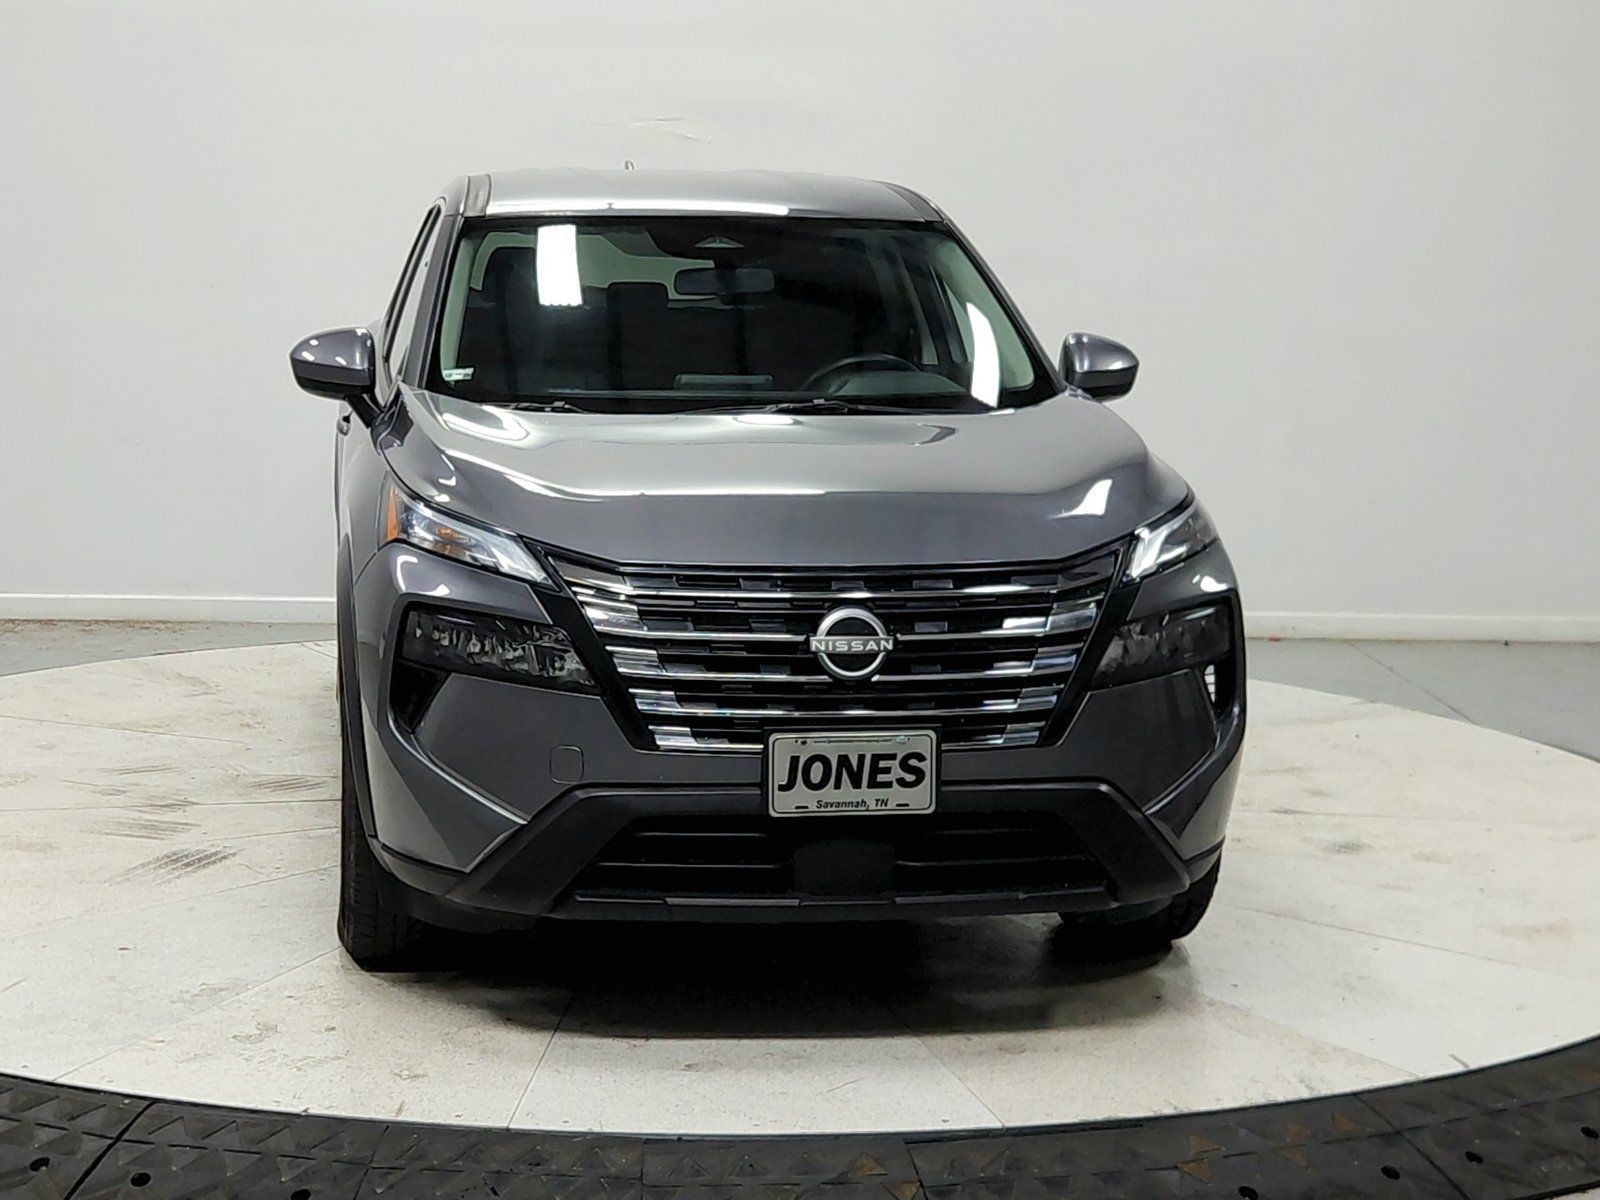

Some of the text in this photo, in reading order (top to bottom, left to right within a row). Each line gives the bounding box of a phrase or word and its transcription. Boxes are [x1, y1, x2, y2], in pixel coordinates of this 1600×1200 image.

[811, 639, 894, 651] NISSAN
[777, 752, 927, 792] JONES
[816, 798, 889, 811] Savannah, TN
